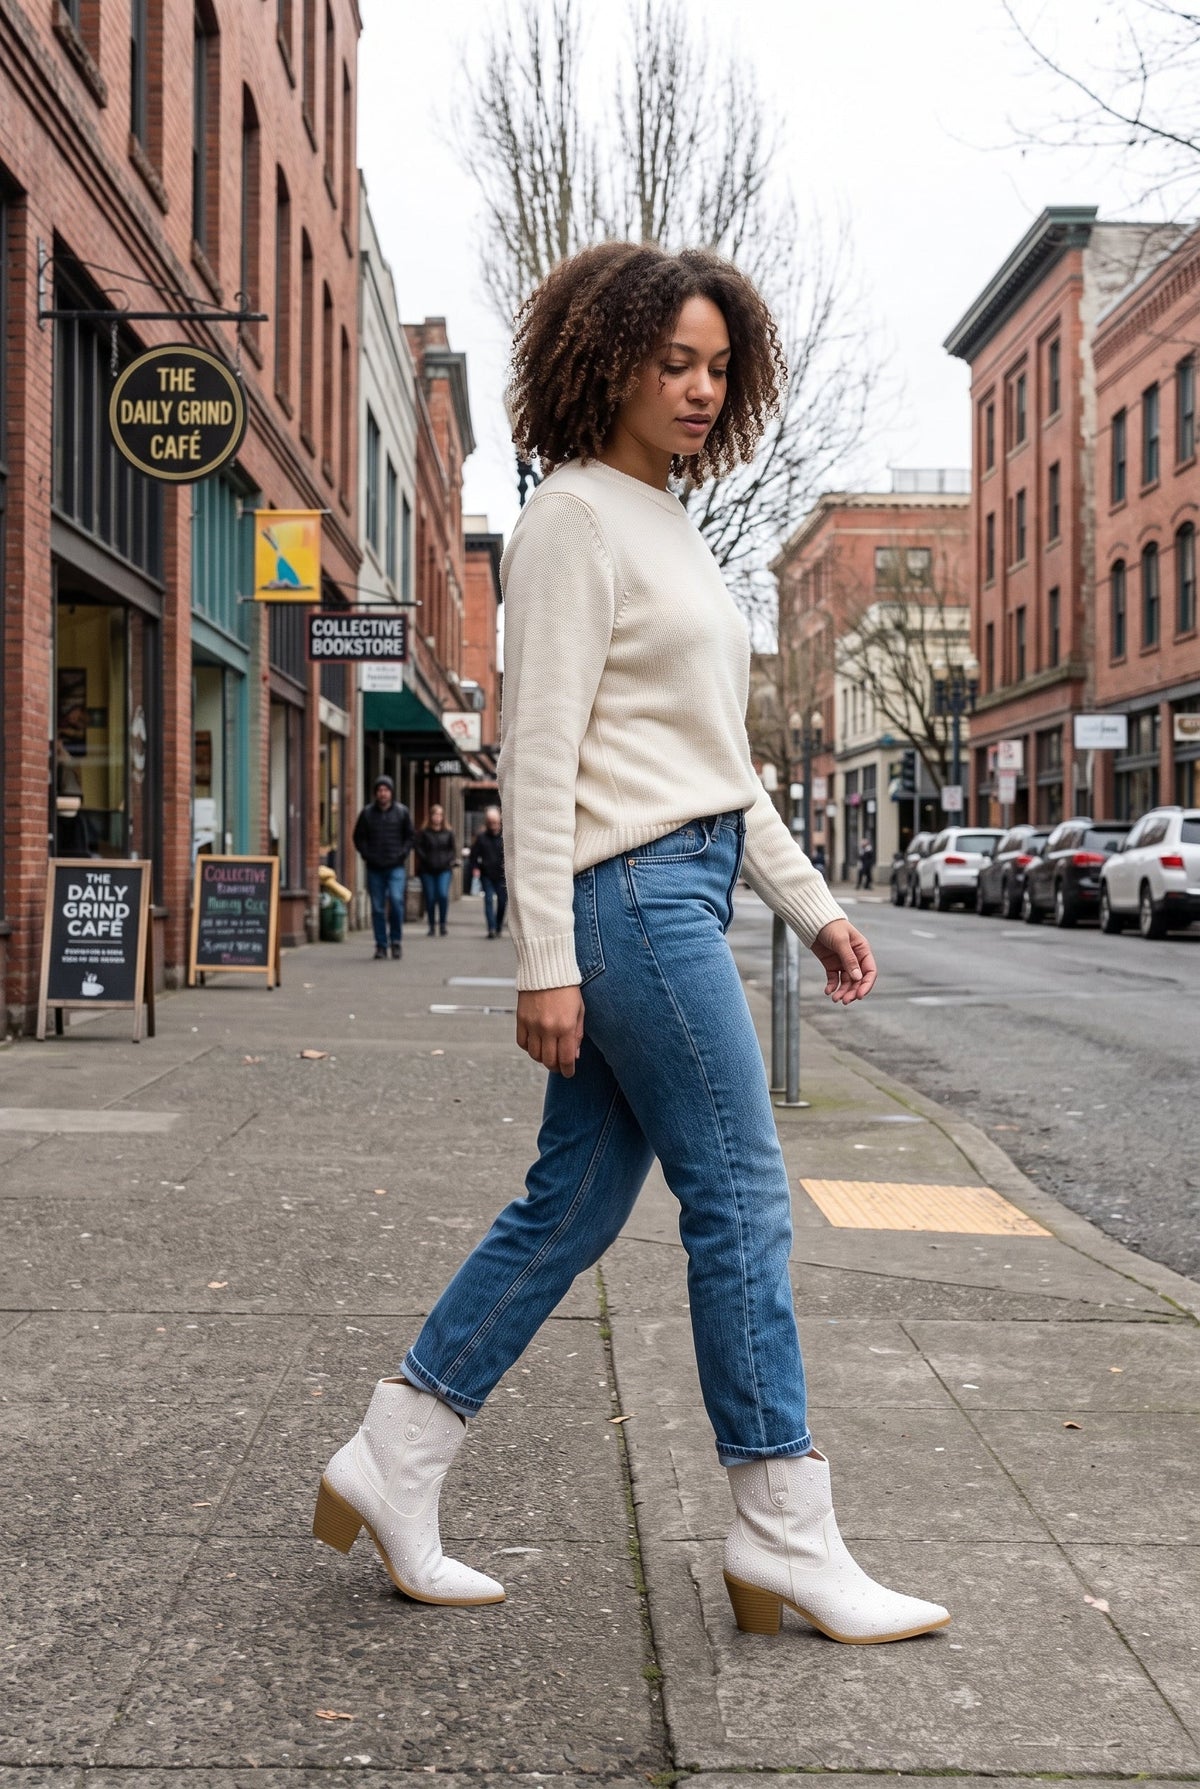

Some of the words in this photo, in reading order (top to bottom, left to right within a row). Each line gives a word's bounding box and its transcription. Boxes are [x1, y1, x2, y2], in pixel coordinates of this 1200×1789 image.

[157, 367, 196, 392] THE
[120, 400, 173, 425] DAILY
[177, 401, 233, 426] GRIND
[150, 429, 202, 460] CAFÉ
[311, 619, 403, 637] COLLECTIVE
[311, 638, 403, 655] BOOKSTORE
[86, 873, 111, 884] THE
[67, 885, 128, 902] DAILY
[62, 902, 130, 919] GRIND
